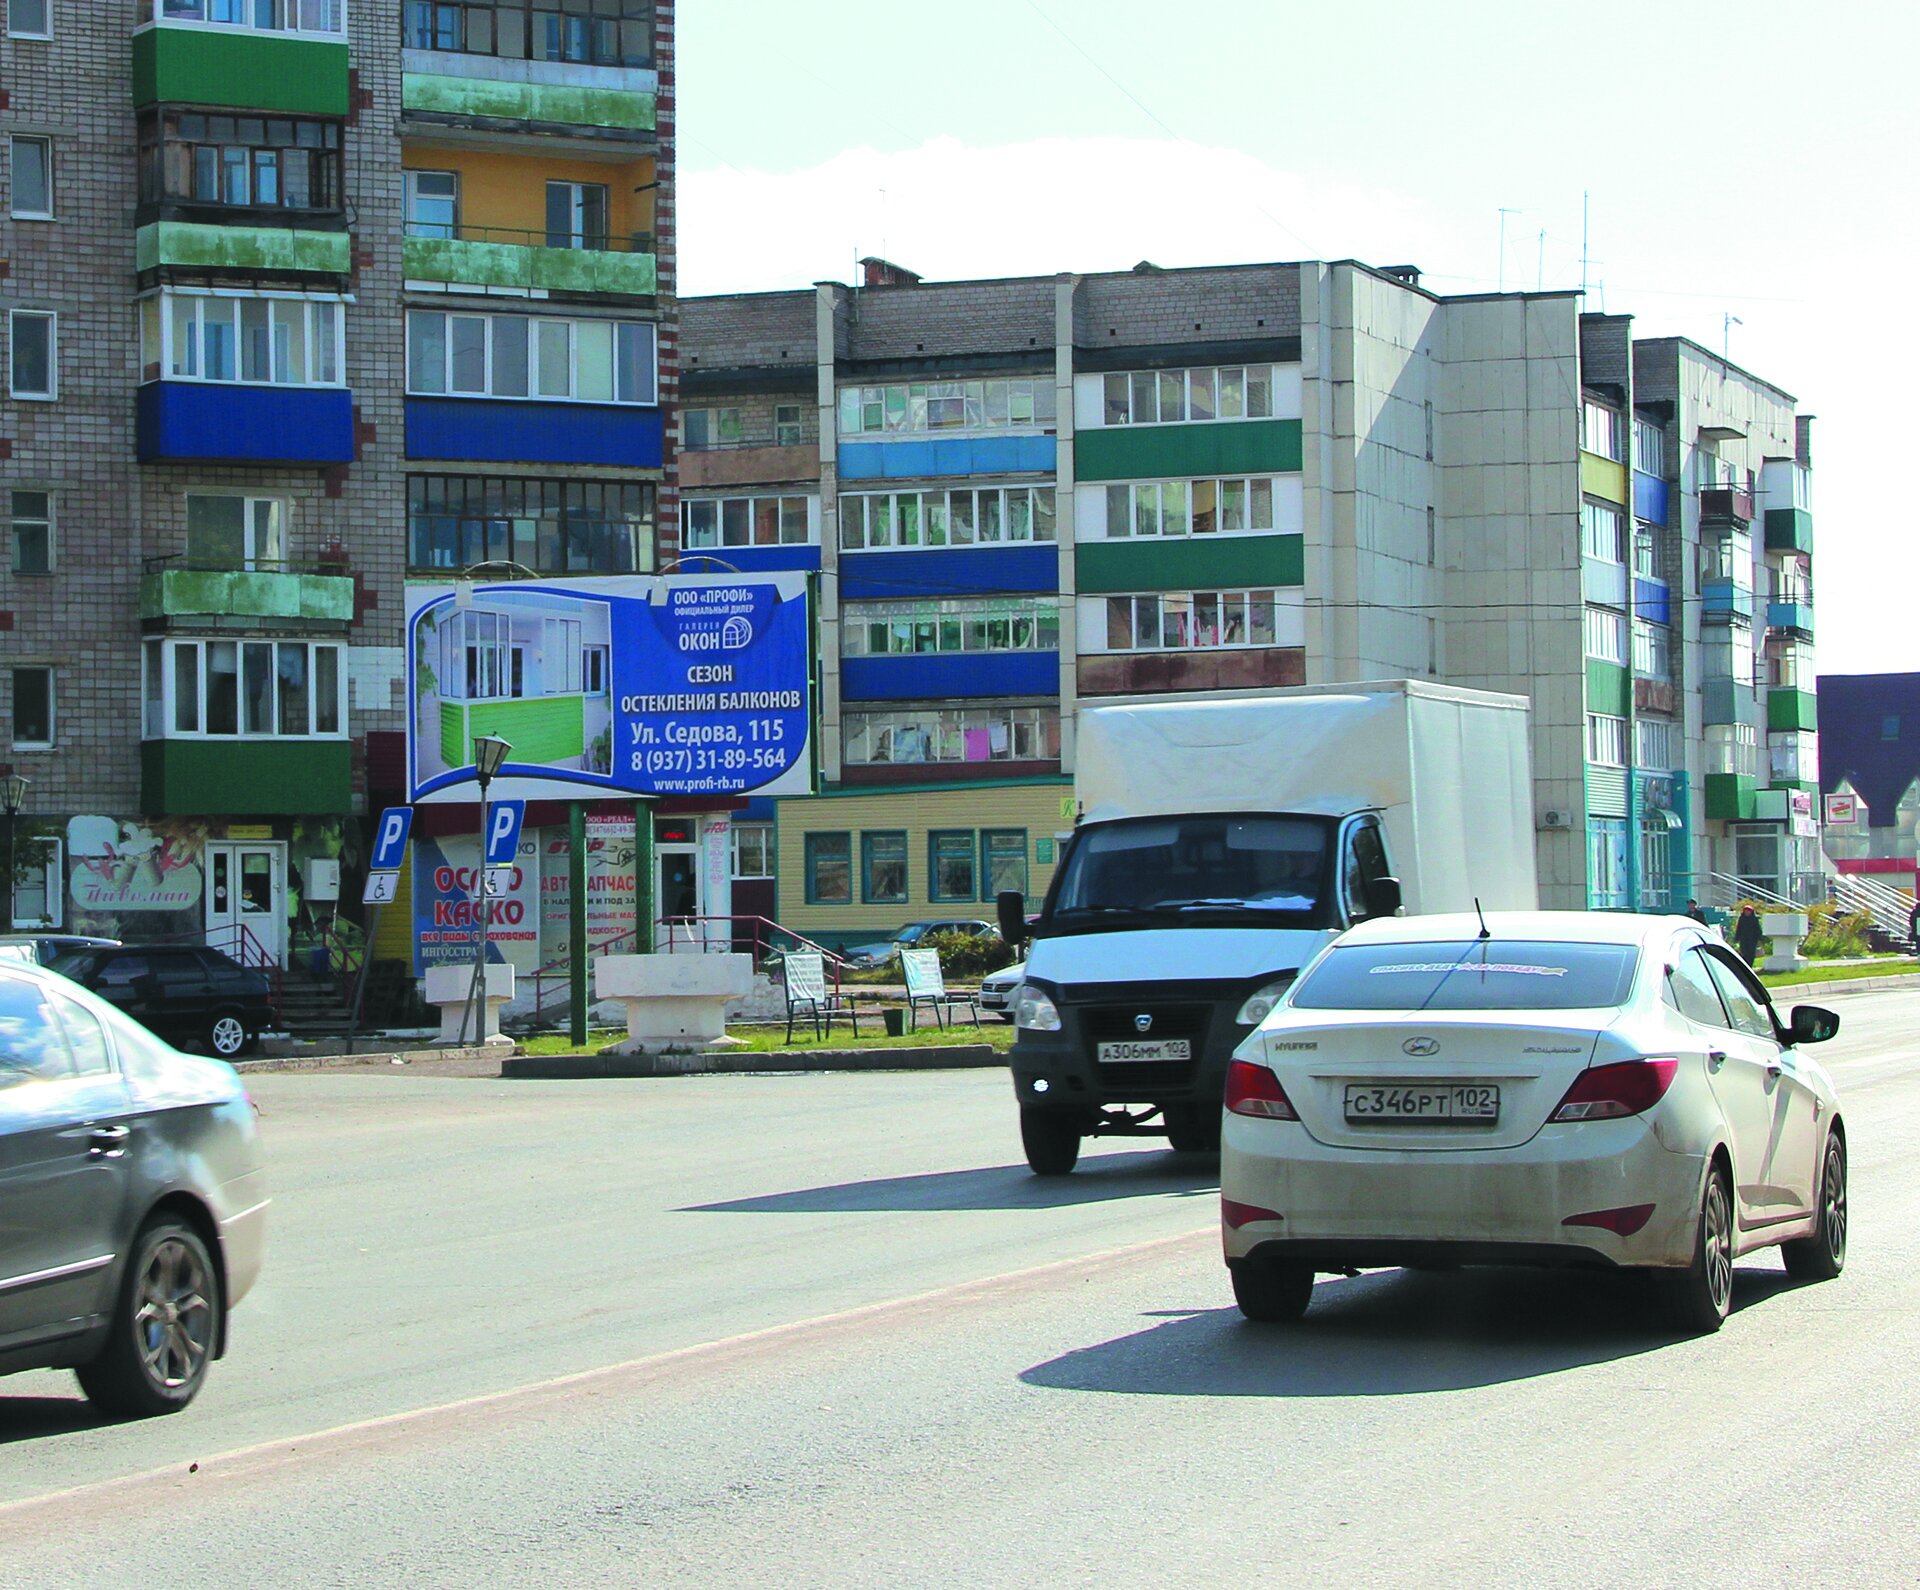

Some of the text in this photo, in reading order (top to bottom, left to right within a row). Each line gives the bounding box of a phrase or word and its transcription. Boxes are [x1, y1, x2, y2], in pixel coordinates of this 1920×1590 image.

[674, 588, 753, 605] ООО «ПРОФИ»
[674, 604, 754, 616] ОФИЦИАЛЬНЫЙ ДИЛЕР
[679, 622, 720, 631] ГАЛЕРЕЯ
[678, 633, 720, 651] ОКОН
[687, 665, 733, 683] СЕЗОН
[621, 690, 801, 713] ОСТЕКЛЕНИЯ БАЛКОНОВ
[631, 719, 784, 747] Ул. Седова, 115
[631, 747, 786, 773] 8 (937) 31-89-564
[654, 776, 745, 792] www.profi-rb.ru
[548, 840, 605, 854] STP
[434, 866, 524, 893] ОСО
[540, 875, 637, 892] АВТАПЧАС
[421, 944, 481, 959] ИНГОССТРА
[1164, 1041, 1187, 1054] 102
[1353, 1088, 1490, 1114] С346РТ 102
[1461, 1107, 1480, 1115] RUS
